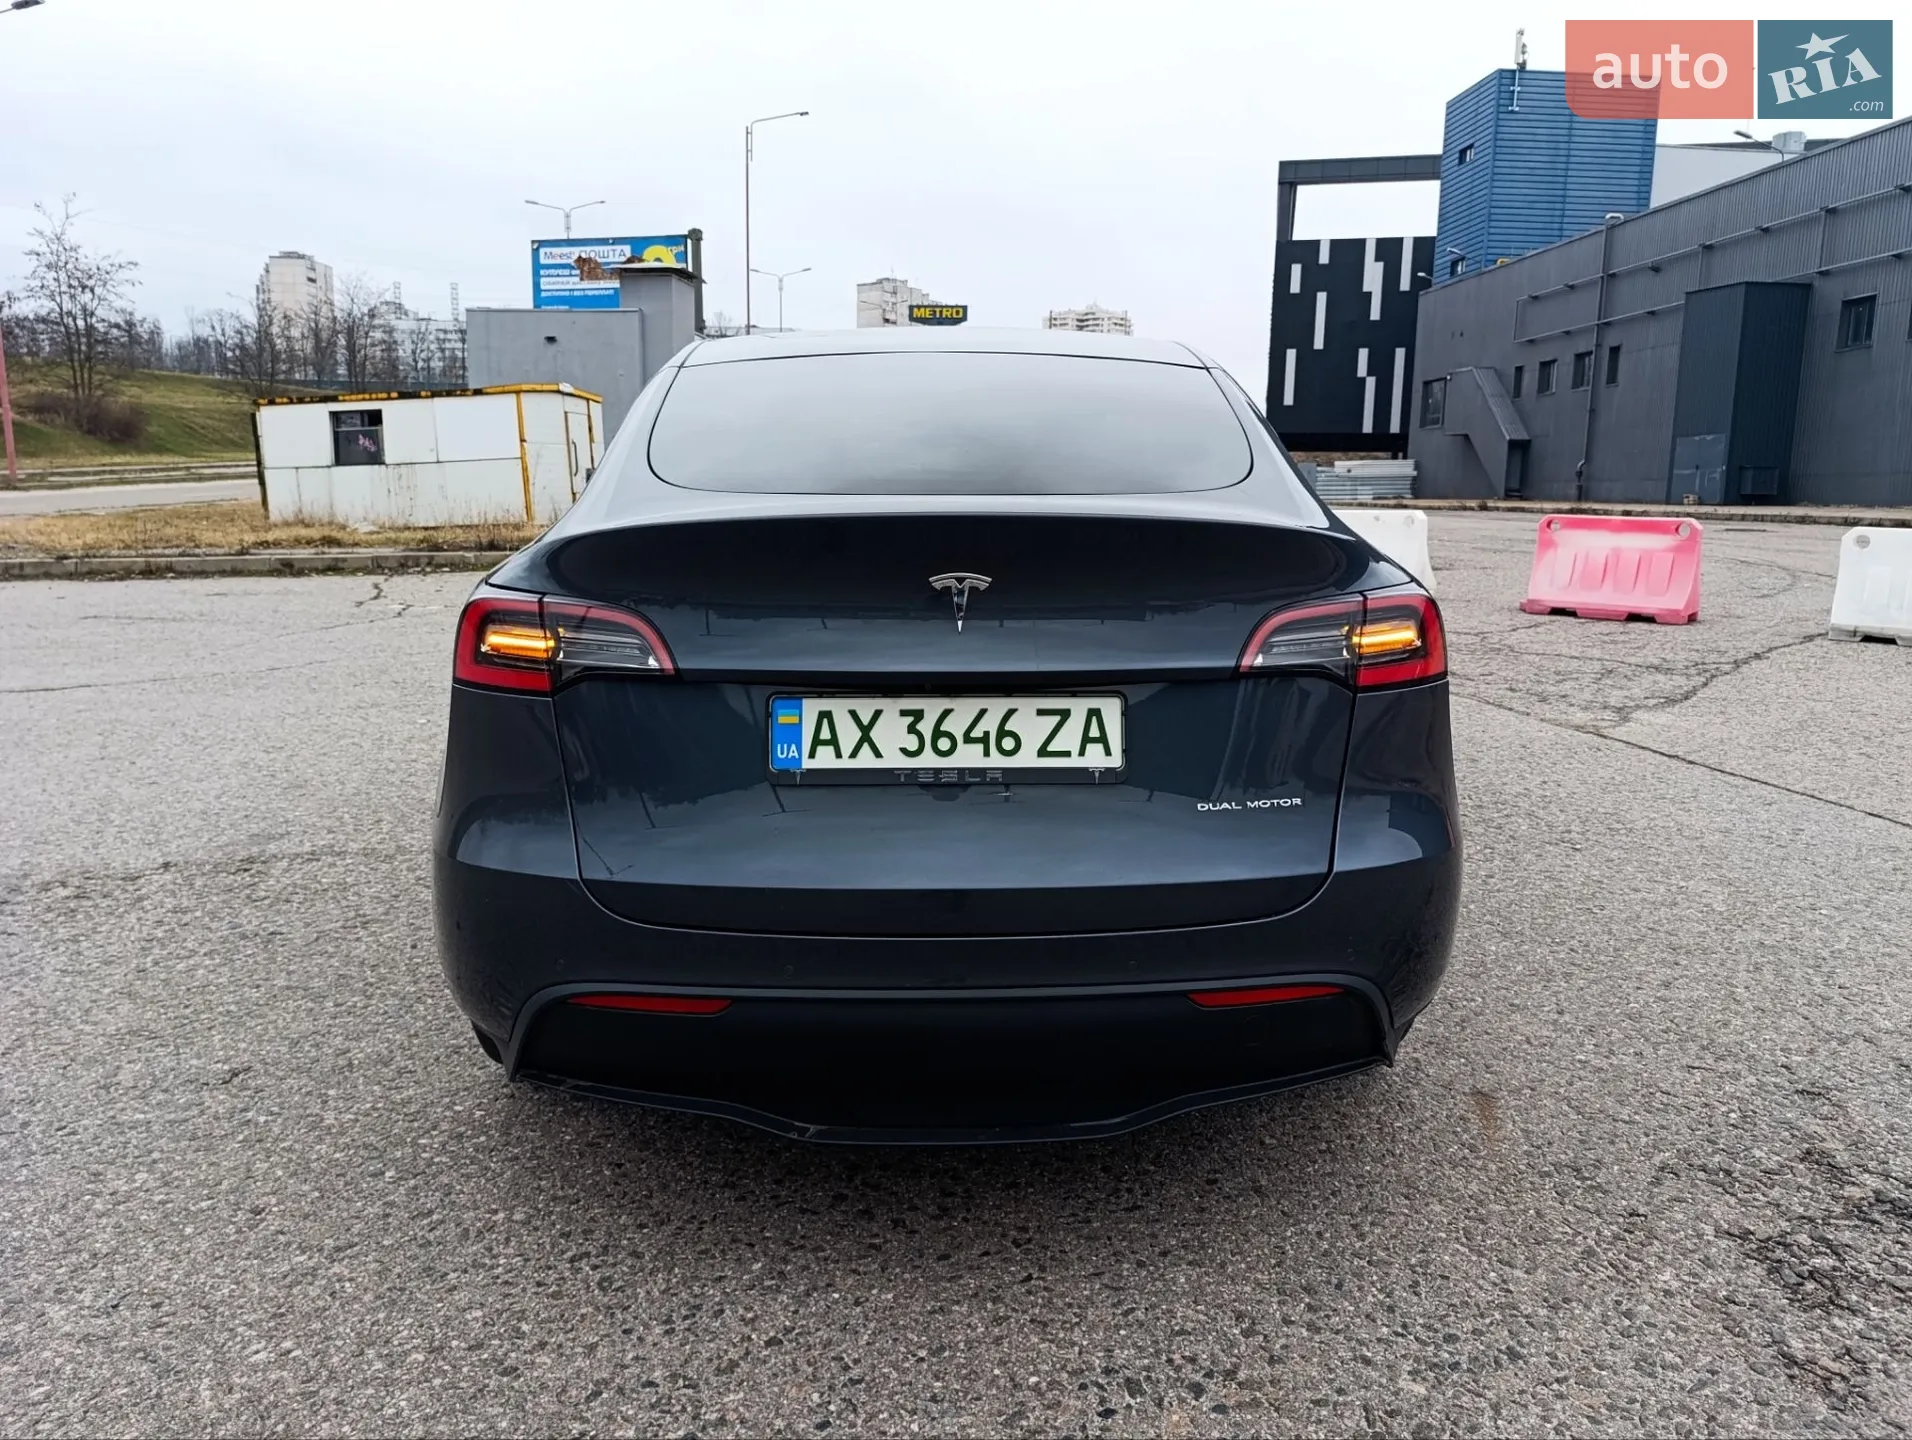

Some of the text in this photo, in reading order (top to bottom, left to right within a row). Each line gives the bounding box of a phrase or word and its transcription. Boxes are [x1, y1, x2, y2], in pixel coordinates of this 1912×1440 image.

[913, 307, 964, 318] METRO
[807, 707, 1113, 760] AX 3646 ZA
[777, 743, 800, 759] UA
[893, 769, 1003, 782] TESLA
[1197, 798, 1302, 811] DUAL MOTOR
